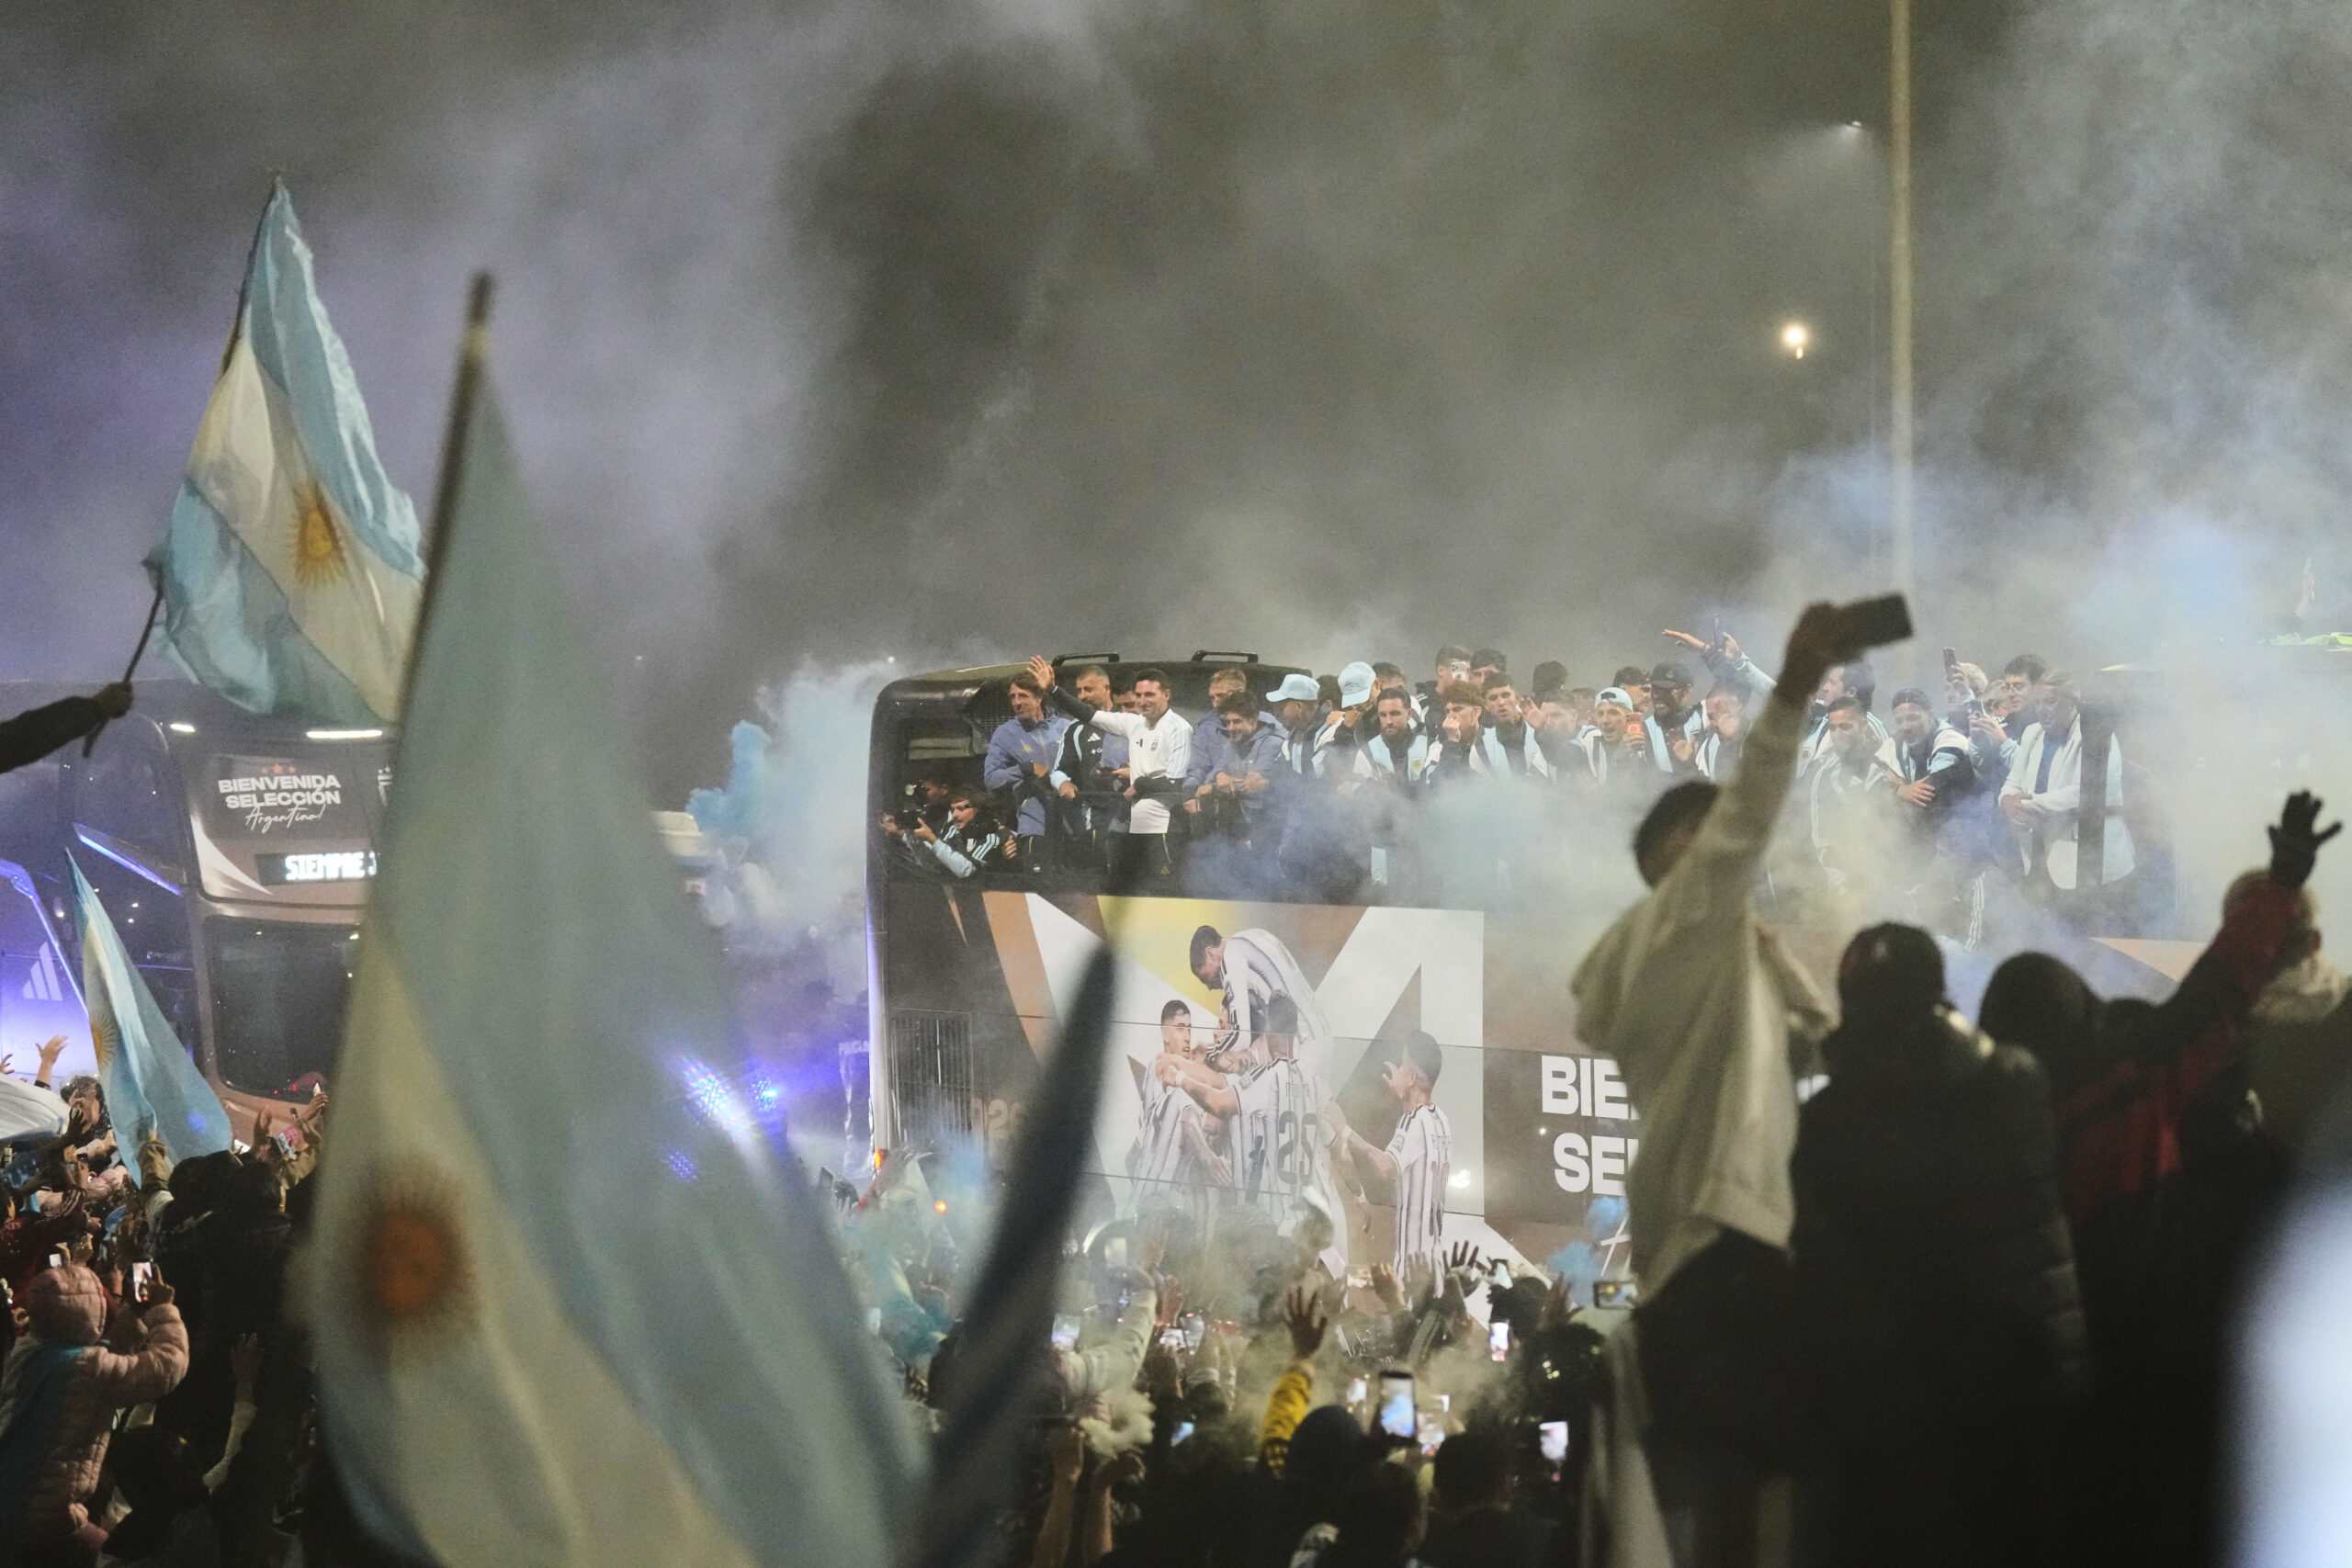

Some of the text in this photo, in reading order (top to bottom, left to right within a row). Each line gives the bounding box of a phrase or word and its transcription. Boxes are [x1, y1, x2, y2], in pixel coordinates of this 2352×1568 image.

[218, 774, 341, 794] BIENVENIDA
[225, 787, 341, 809] SELECCIÓN
[1542, 1055, 1640, 1120] BIE
